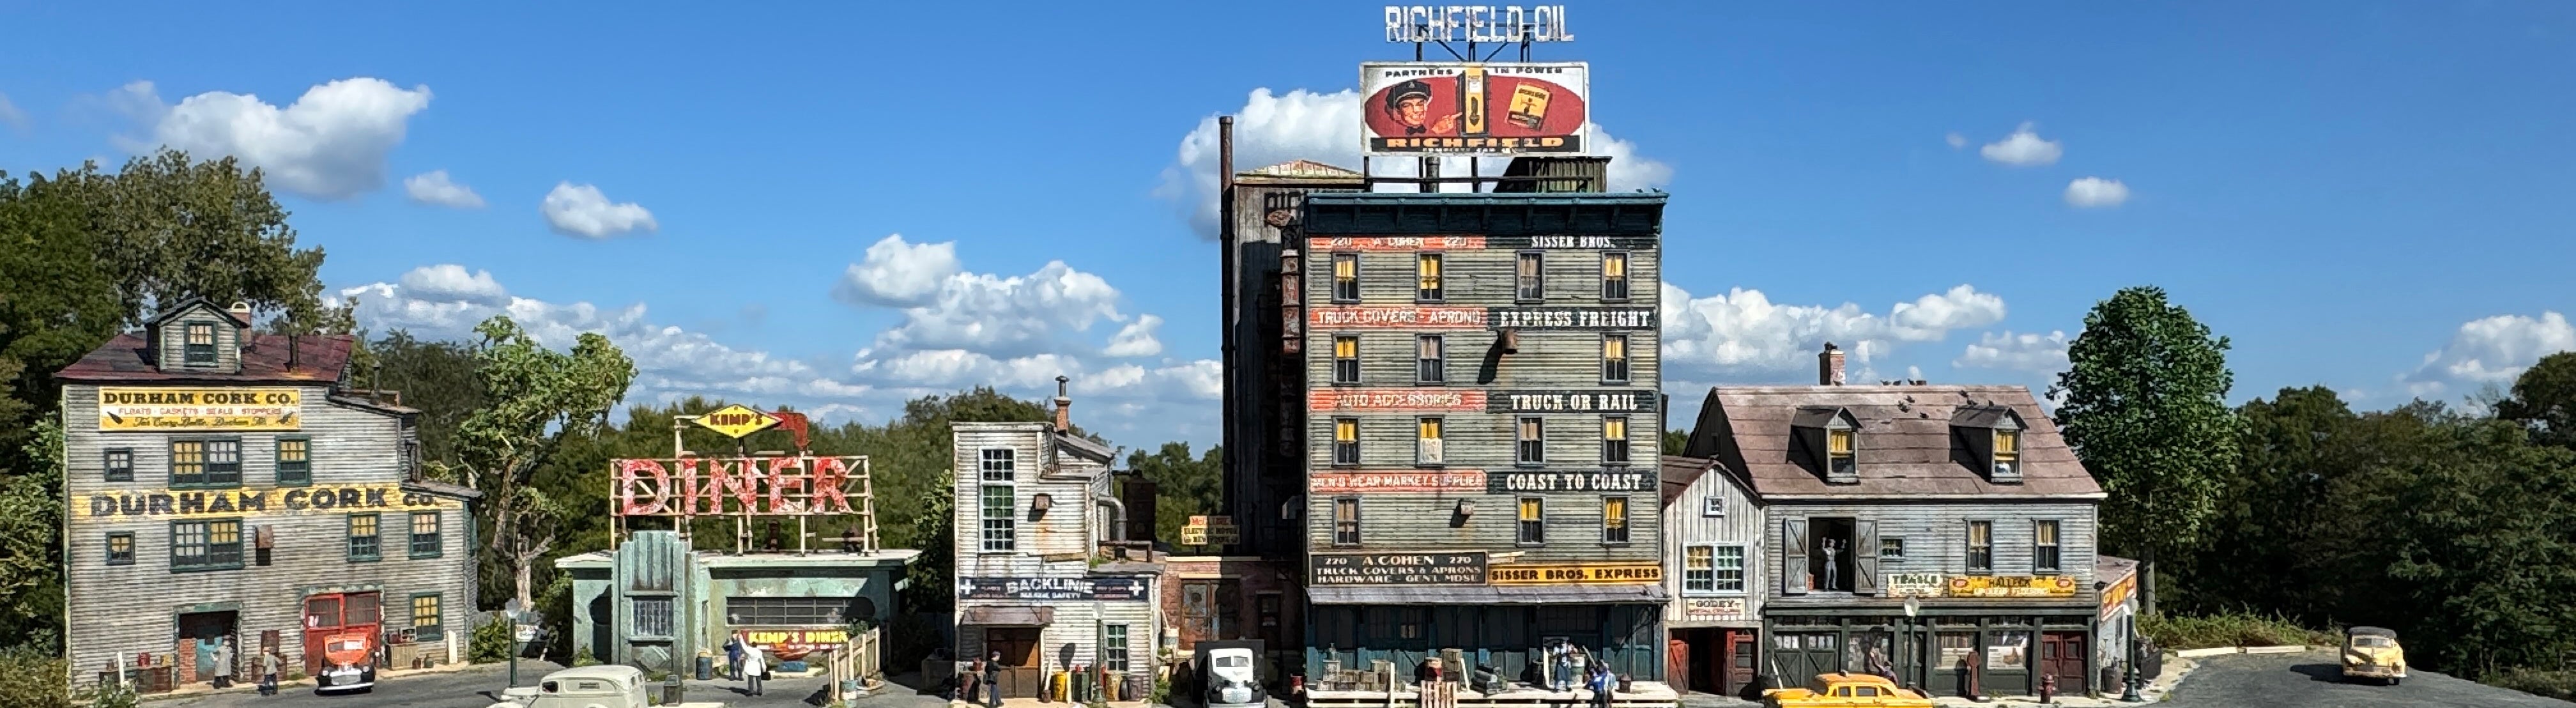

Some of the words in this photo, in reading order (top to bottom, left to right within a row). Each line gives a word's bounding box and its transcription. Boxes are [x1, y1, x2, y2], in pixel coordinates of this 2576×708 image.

[1384, 6, 1523, 43] RICHFIELD
[1535, 5, 1575, 42] OIL
[1385, 68, 1454, 78] PARTNERS
[1516, 66, 1563, 74] POWER
[1386, 137, 1564, 148] RICHFIELD
[1317, 311, 1358, 324] TRUCK
[1430, 311, 1481, 324] APRONS
[1499, 311, 1572, 327] EXPRESS
[1579, 311, 1650, 327] FREIGHT
[103, 392, 194, 404] DURHAM
[203, 392, 257, 404] CORK
[266, 392, 297, 404] CO.
[1510, 394, 1563, 410] TRUCK
[1570, 394, 1591, 410] OR
[1598, 394, 1638, 411] RAIL
[118, 407, 152, 415] FLOATS
[710, 413, 763, 426] KEMP'S
[622, 457, 853, 515] DINER
[1349, 475, 1381, 488] WEAR
[1383, 475, 1429, 487] MARKET
[1506, 473, 1558, 490] COAST
[1565, 473, 1584, 490] TO
[1591, 473, 1642, 490] COAST
[90, 491, 266, 517] DURHAM
[284, 487, 388, 510] CORK
[402, 492, 439, 507] CO.
[1449, 557, 1471, 565] 220
[1362, 567, 1415, 575] COVERS
[1431, 566, 1482, 574] APRONS
[1491, 569, 1539, 581] SISSER
[1545, 569, 1589, 580] BROS.
[1595, 568, 1659, 580] EXPRESS
[1317, 575, 1393, 583] HARDWARE
[1006, 578, 1095, 594] BACKLINE
[748, 631, 800, 643] KEMP'S
[805, 631, 848, 643] DINER
